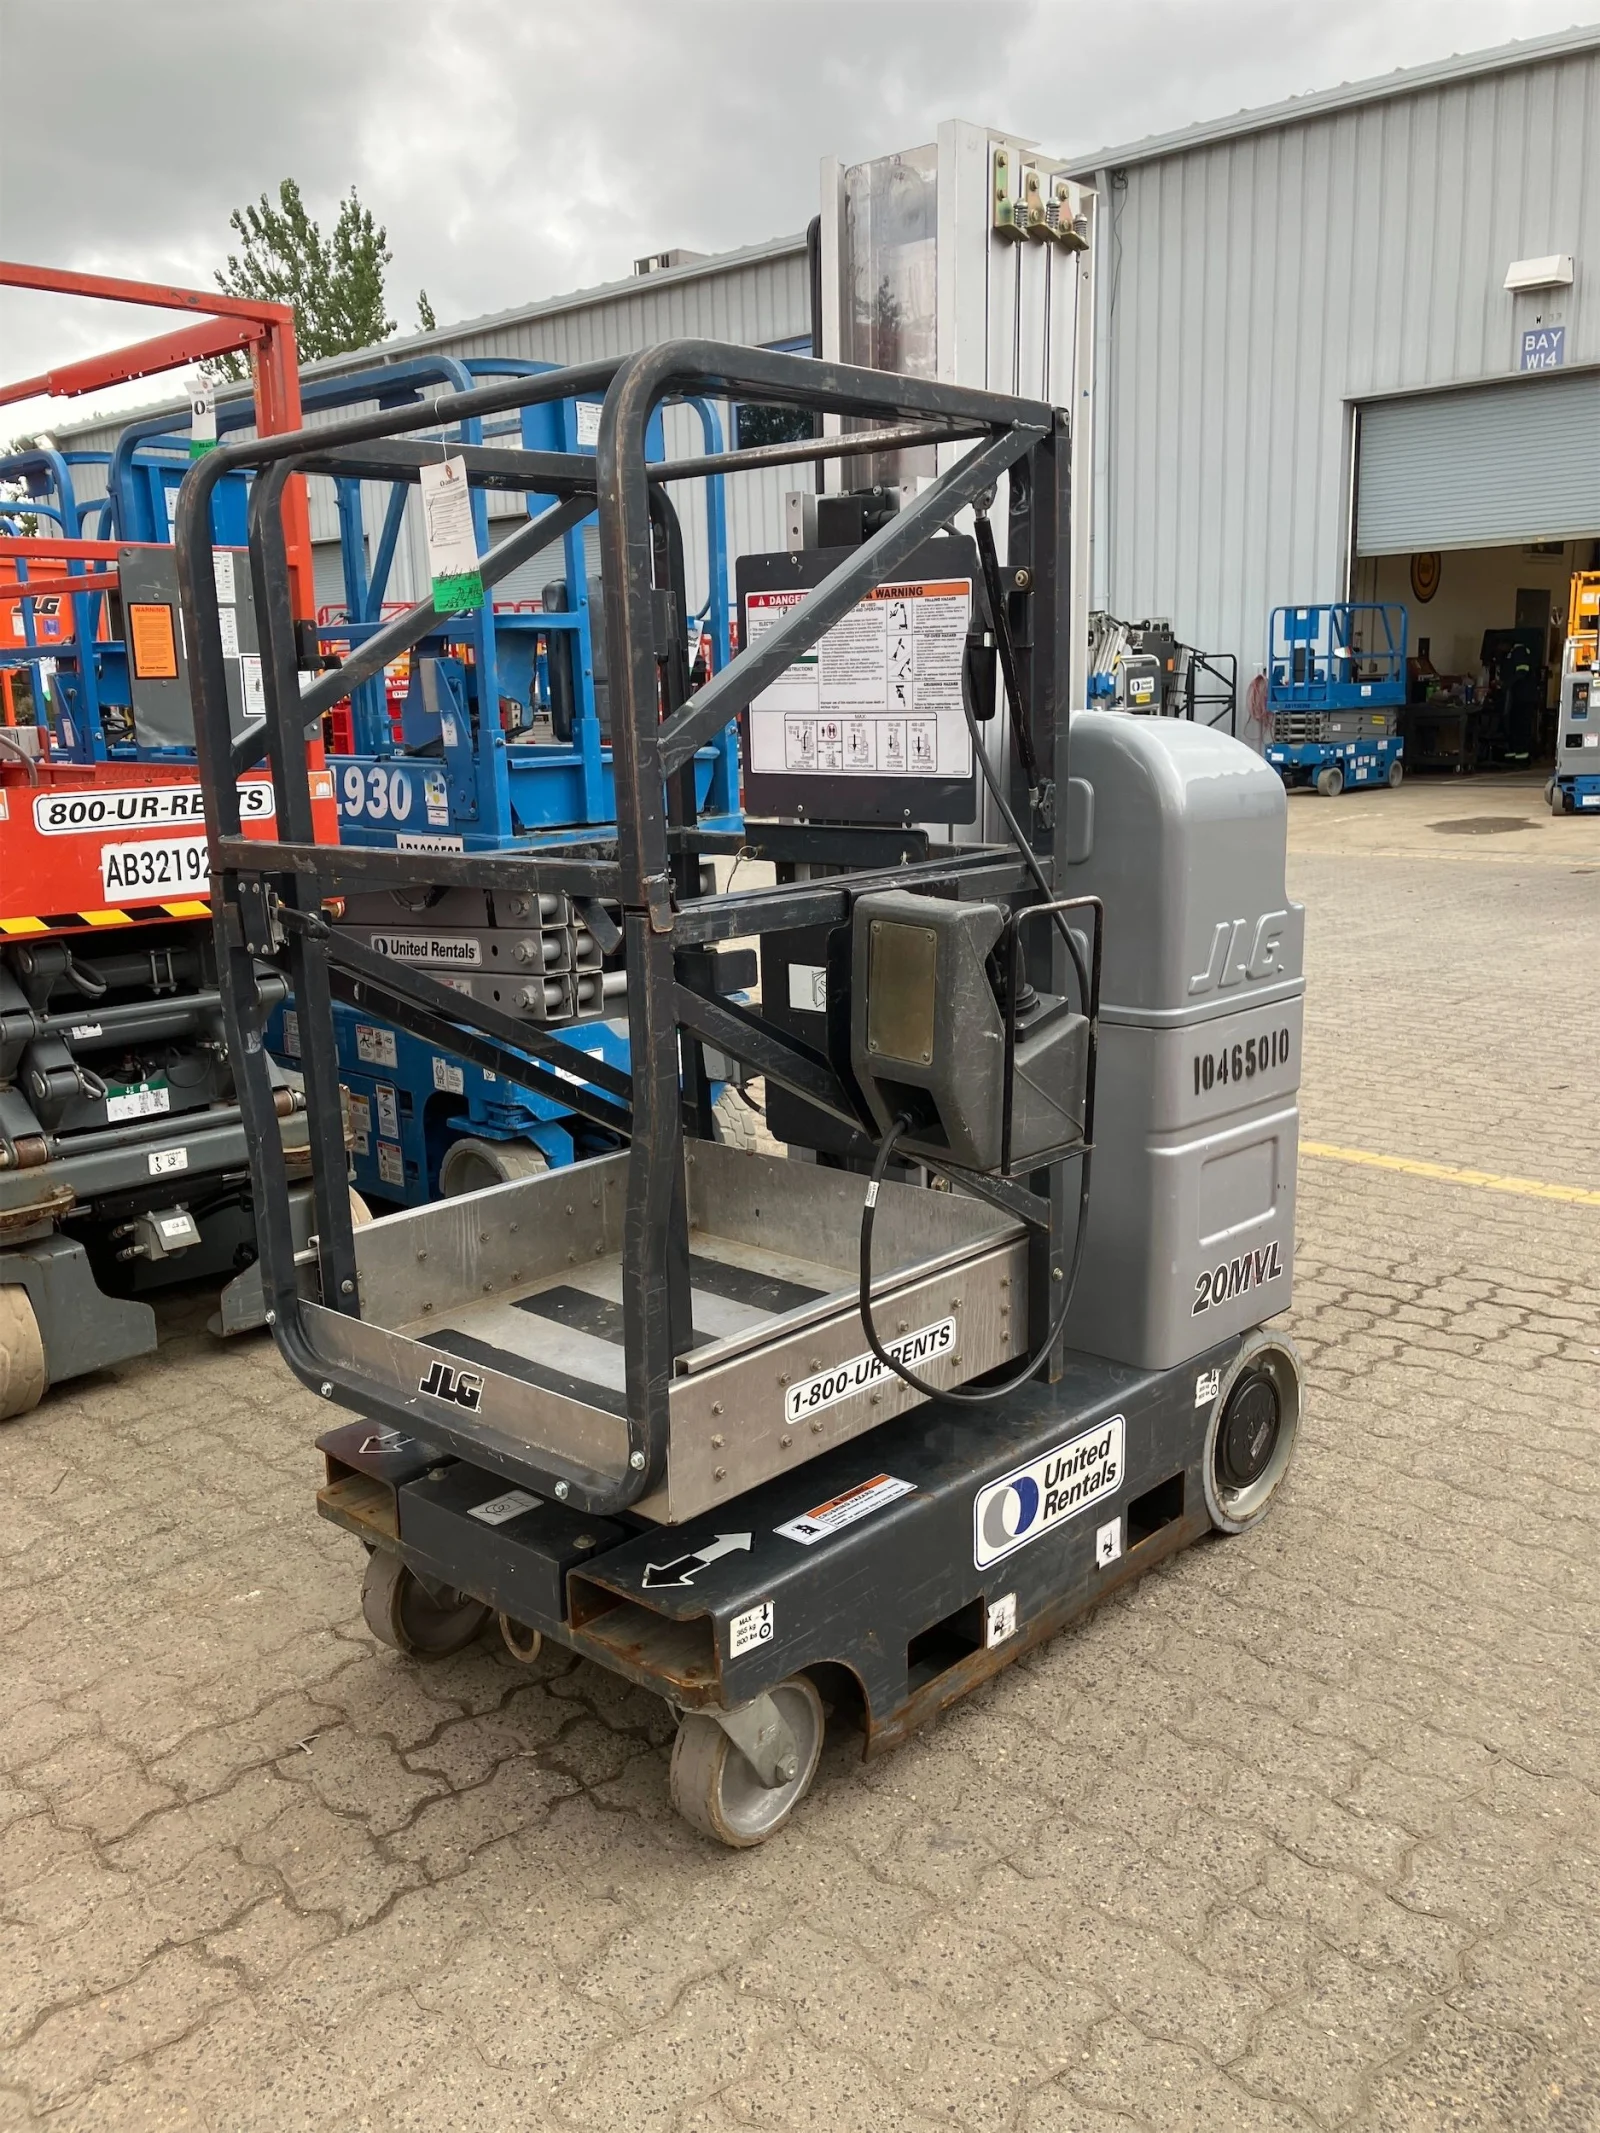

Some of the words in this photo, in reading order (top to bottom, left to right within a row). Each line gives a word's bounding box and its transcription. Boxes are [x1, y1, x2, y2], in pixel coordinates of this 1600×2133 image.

[1525, 331, 1562, 351] BAY
[1526, 351, 1557, 370] W14
[876, 586, 923, 599] WARNING
[391, 940, 427, 956] United
[431, 941, 475, 958] Rentals
[1188, 910, 1289, 996] JLG
[1194, 1028, 1289, 1095] 10465010
[1192, 1241, 1283, 1316] 20MVL
[418, 1360, 484, 1412] JLG
[1044, 1430, 1112, 1489] United
[1043, 1460, 1117, 1520] Rentals
